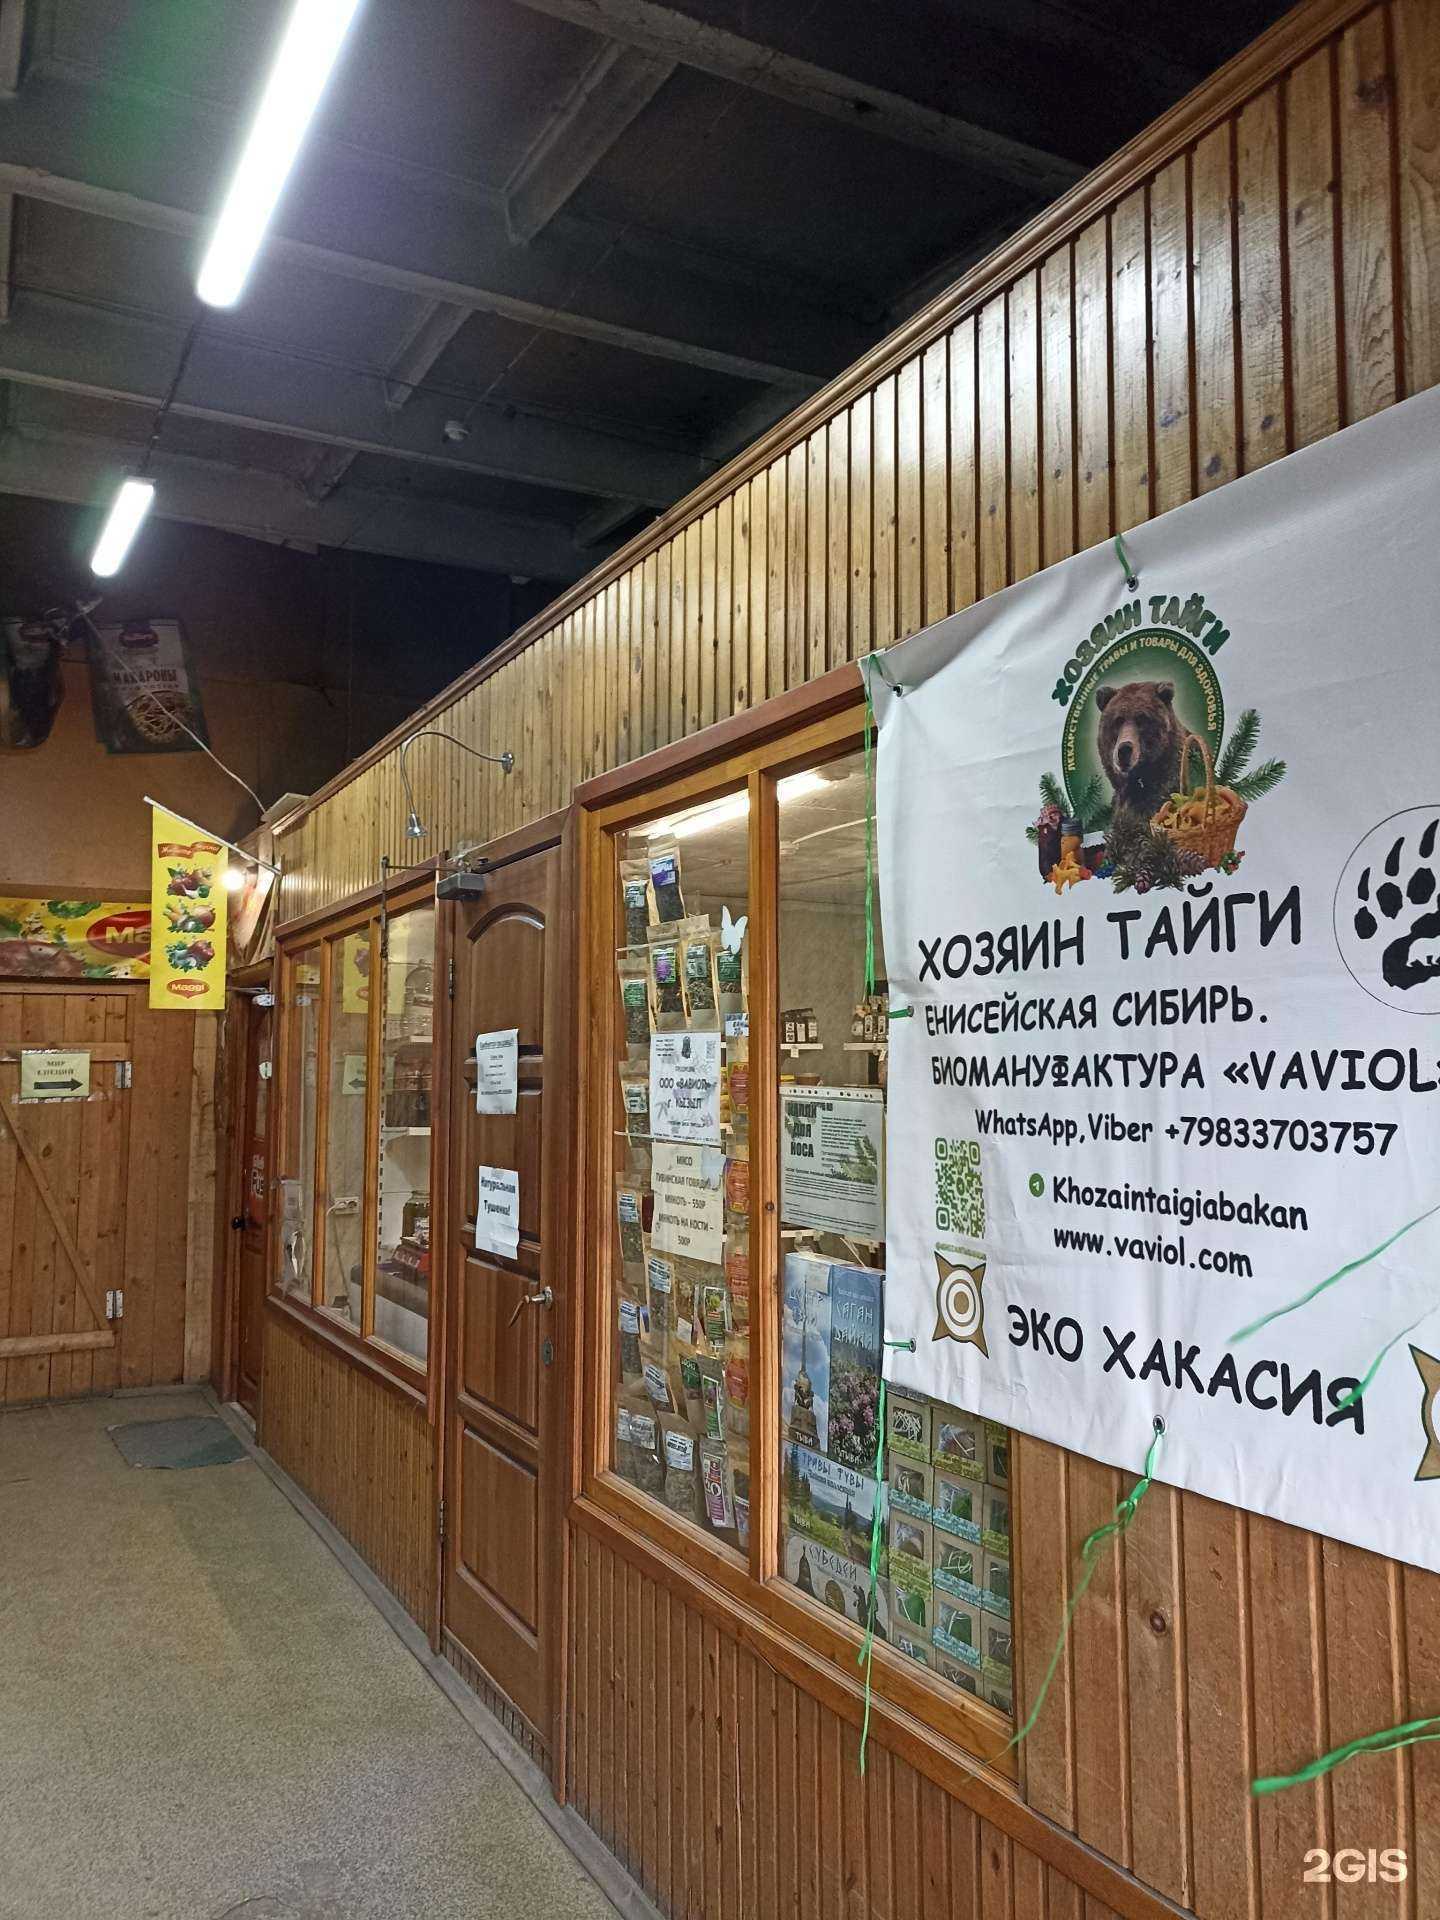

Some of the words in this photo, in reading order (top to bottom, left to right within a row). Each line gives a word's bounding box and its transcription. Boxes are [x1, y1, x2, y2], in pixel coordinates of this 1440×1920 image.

[1052, 599, 1141, 706] ХОЗЯИН
[1149, 592, 1231, 656] ТАЙГИ
[1099, 643, 1129, 673] ТРАВЫ
[1140, 636, 1179, 652] ТОВАРЫ
[1177, 645, 1198, 668] ДЛЯ
[1195, 663, 1217, 731] ЗДОРОВЬЯ
[919, 916, 1084, 982] ХОЗЯИН
[1107, 881, 1301, 960] ТАЙГИ
[171, 983, 206, 993] Maggi
[926, 991, 1097, 1037] ЕНИСЕЙСКАЯ
[1112, 984, 1269, 1027] СИБИРЬ.
[659, 1077, 674, 1089] ООО
[932, 1053, 1205, 1089] БИОМАНУФАКТУРА
[790, 1141, 814, 1158] НОСА
[792, 1122, 812, 1138] ДЛЯ
[1165, 1116, 1399, 1157] +79833703757
[676, 1155, 693, 1167] МЯСО
[1053, 1175, 1309, 1231] Khozaintaigiabakan
[681, 1217, 689, 1228] НА
[690, 1219, 709, 1231] КОСТИ
[1053, 1227, 1254, 1279] www.vaviol.com
[1008, 1304, 1084, 1363] ЭКО
[1103, 1325, 1365, 1435] ХАКАСИЯ
